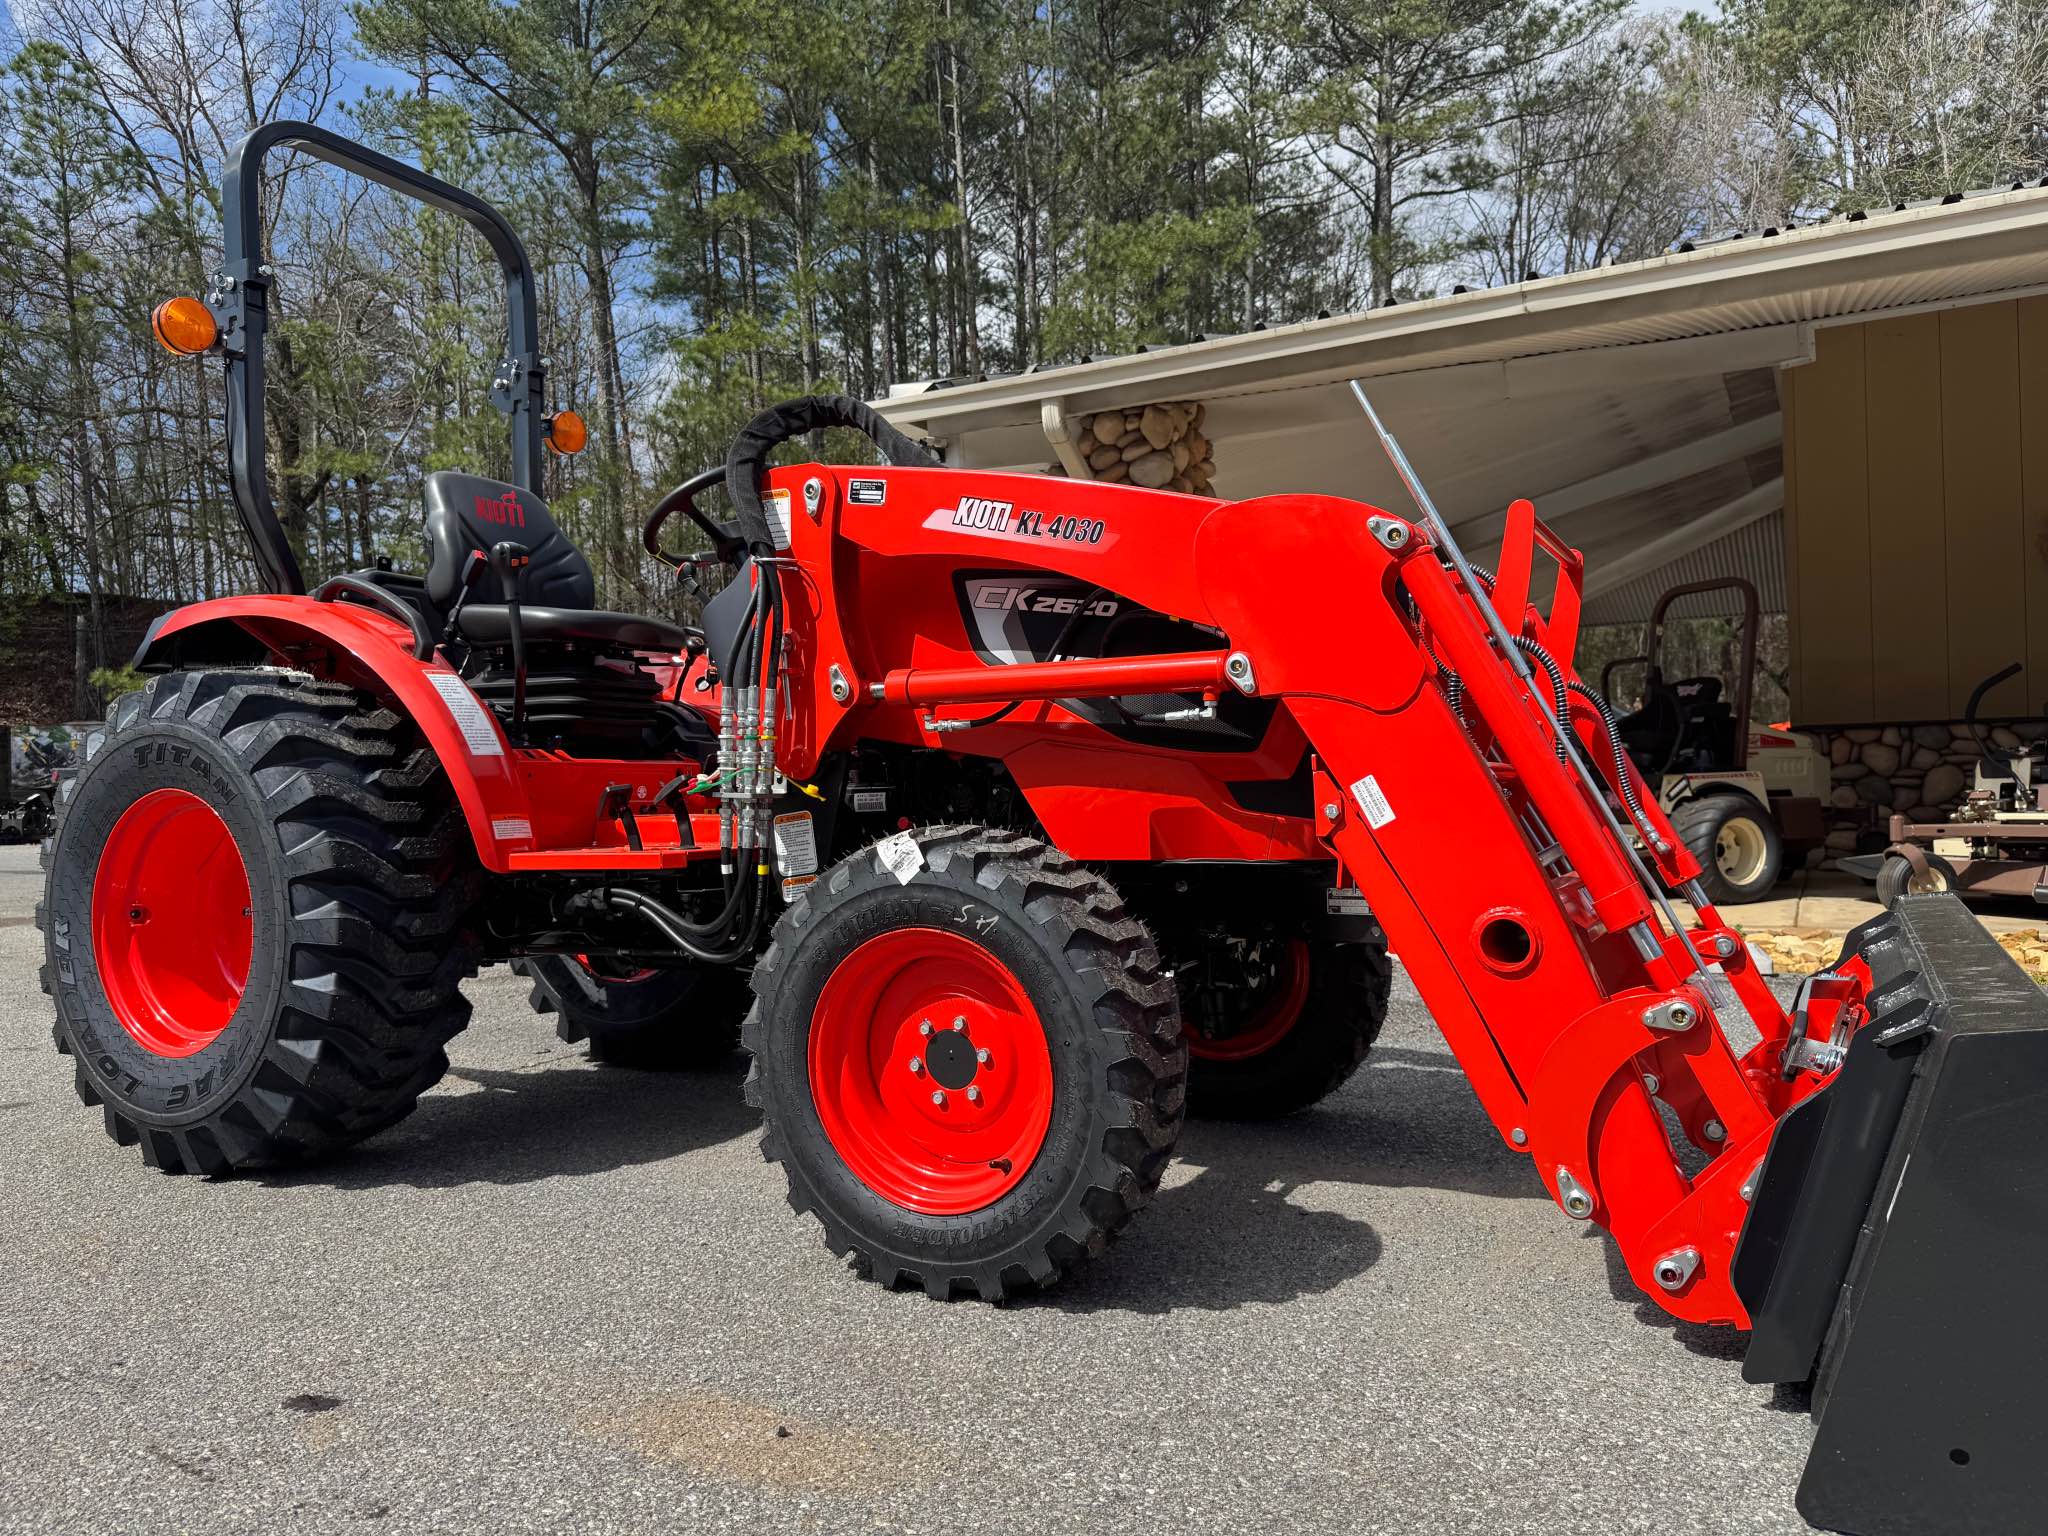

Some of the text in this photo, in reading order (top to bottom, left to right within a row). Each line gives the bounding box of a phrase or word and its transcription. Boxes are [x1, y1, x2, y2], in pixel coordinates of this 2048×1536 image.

[473, 493, 526, 529] KIOTI
[952, 495, 1106, 544] KIOTI KL 4030
[133, 741, 239, 806] TITAN
[53, 918, 144, 1097] LOADER
